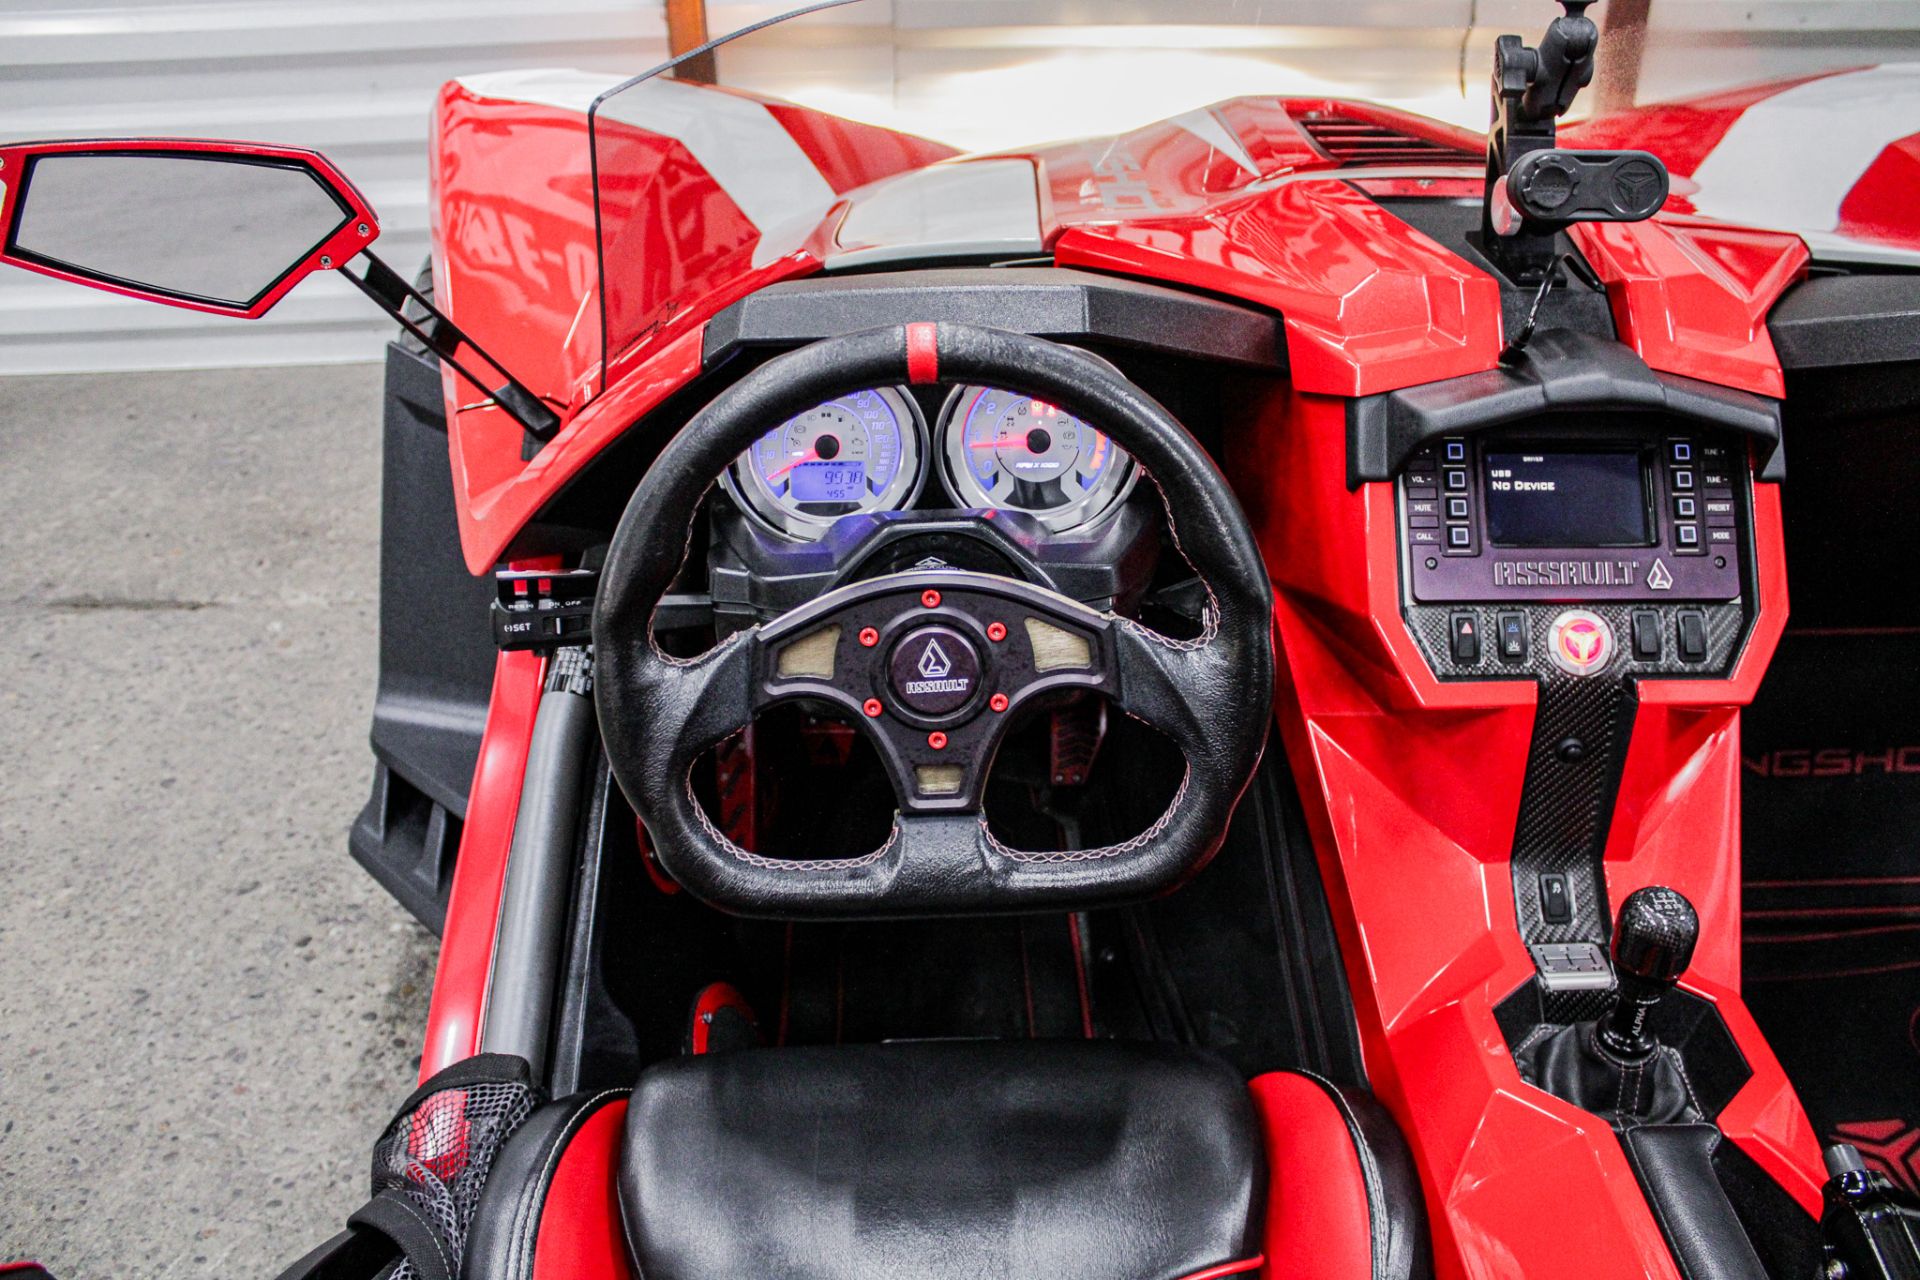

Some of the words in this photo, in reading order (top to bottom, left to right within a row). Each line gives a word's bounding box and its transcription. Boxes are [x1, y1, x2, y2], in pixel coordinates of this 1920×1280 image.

[985, 402, 997, 415] 2
[863, 411, 879, 419] 100
[871, 422, 886, 430] 110
[827, 489, 845, 498] 455
[1414, 504, 1432, 512] MUTE
[1707, 503, 1731, 512] PRESET
[1416, 532, 1433, 540] CALL
[1712, 532, 1731, 540] MODE
[1493, 561, 1640, 586] ASSAULT
[906, 679, 968, 693] ASSAULT
[1631, 1007, 1648, 1037] ALPHA
